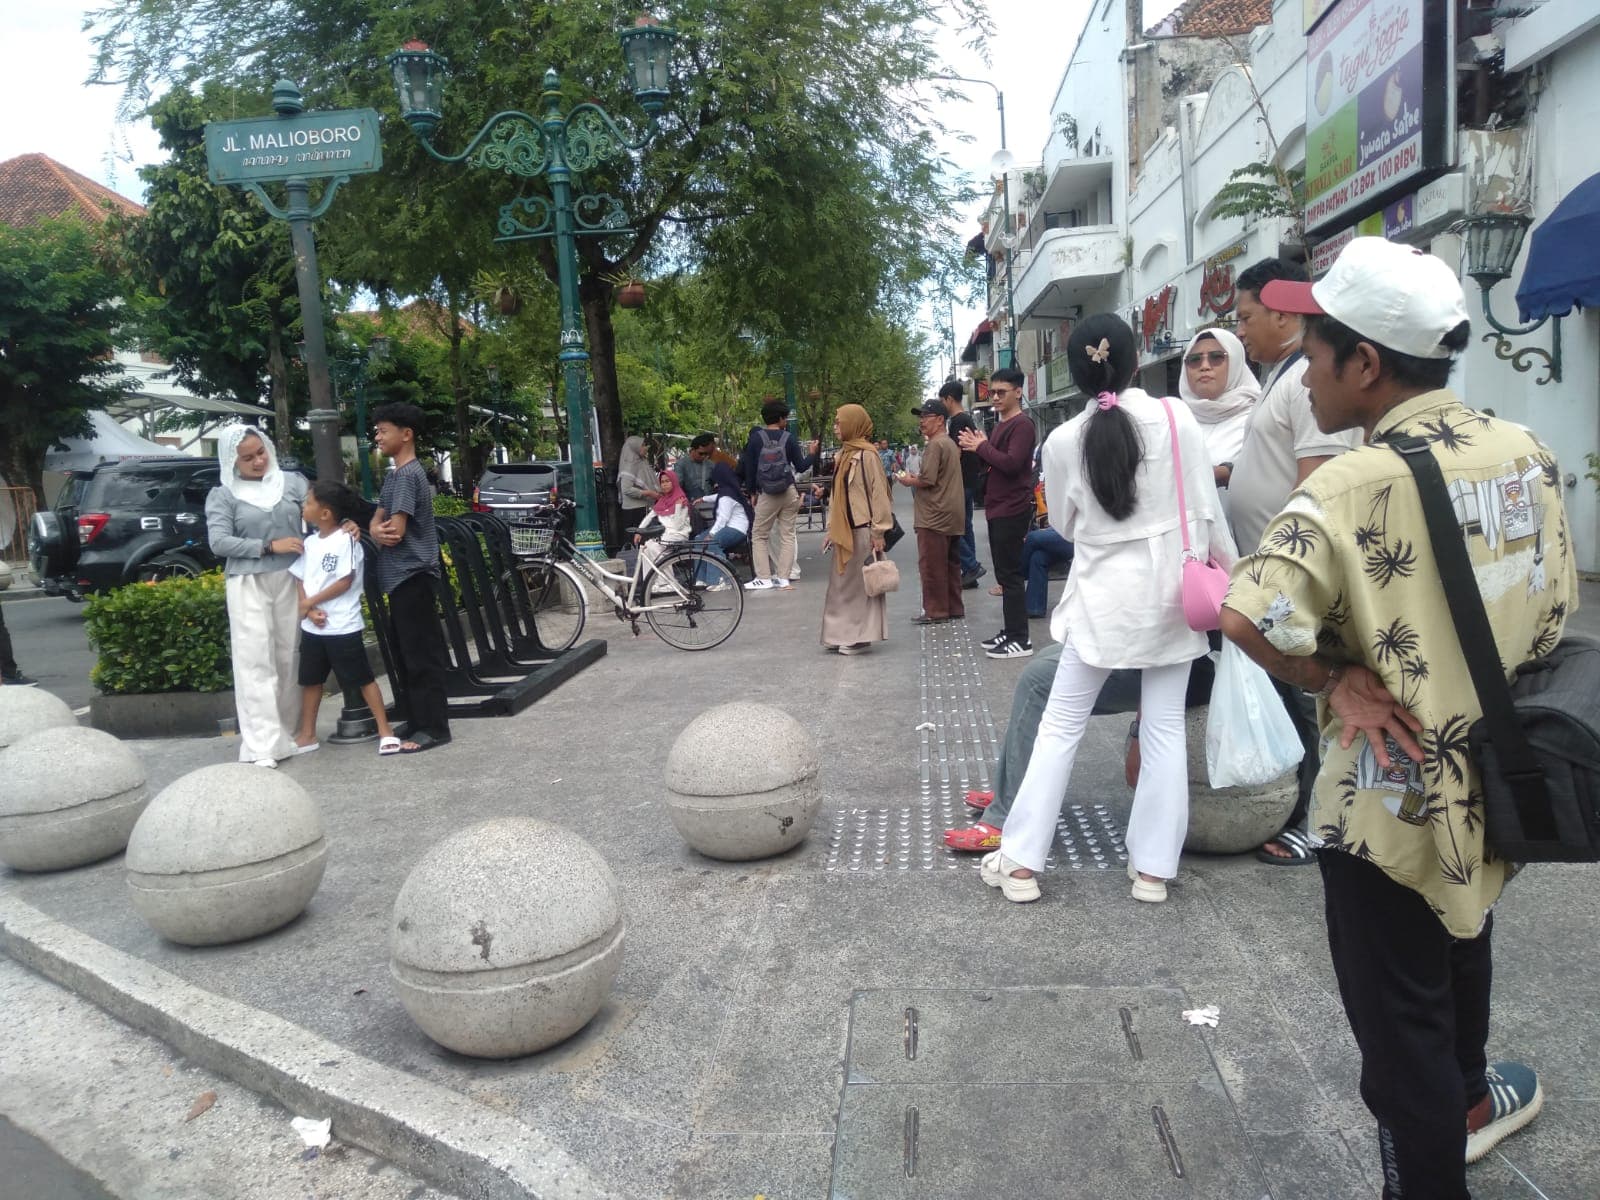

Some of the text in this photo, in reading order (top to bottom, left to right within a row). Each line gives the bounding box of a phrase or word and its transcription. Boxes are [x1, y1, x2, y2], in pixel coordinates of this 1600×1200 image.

[1340, 46, 1369, 94] tugu
[1365, 6, 1409, 77] jogja
[223, 125, 361, 152] JL. MALIOBORO
[1360, 130, 1390, 166] juwara
[1350, 178, 1359, 198] 12
[1359, 170, 1376, 194] BOX
[1378, 157, 1392, 183] 100
[1381, 1127, 1403, 1196] MOVING
